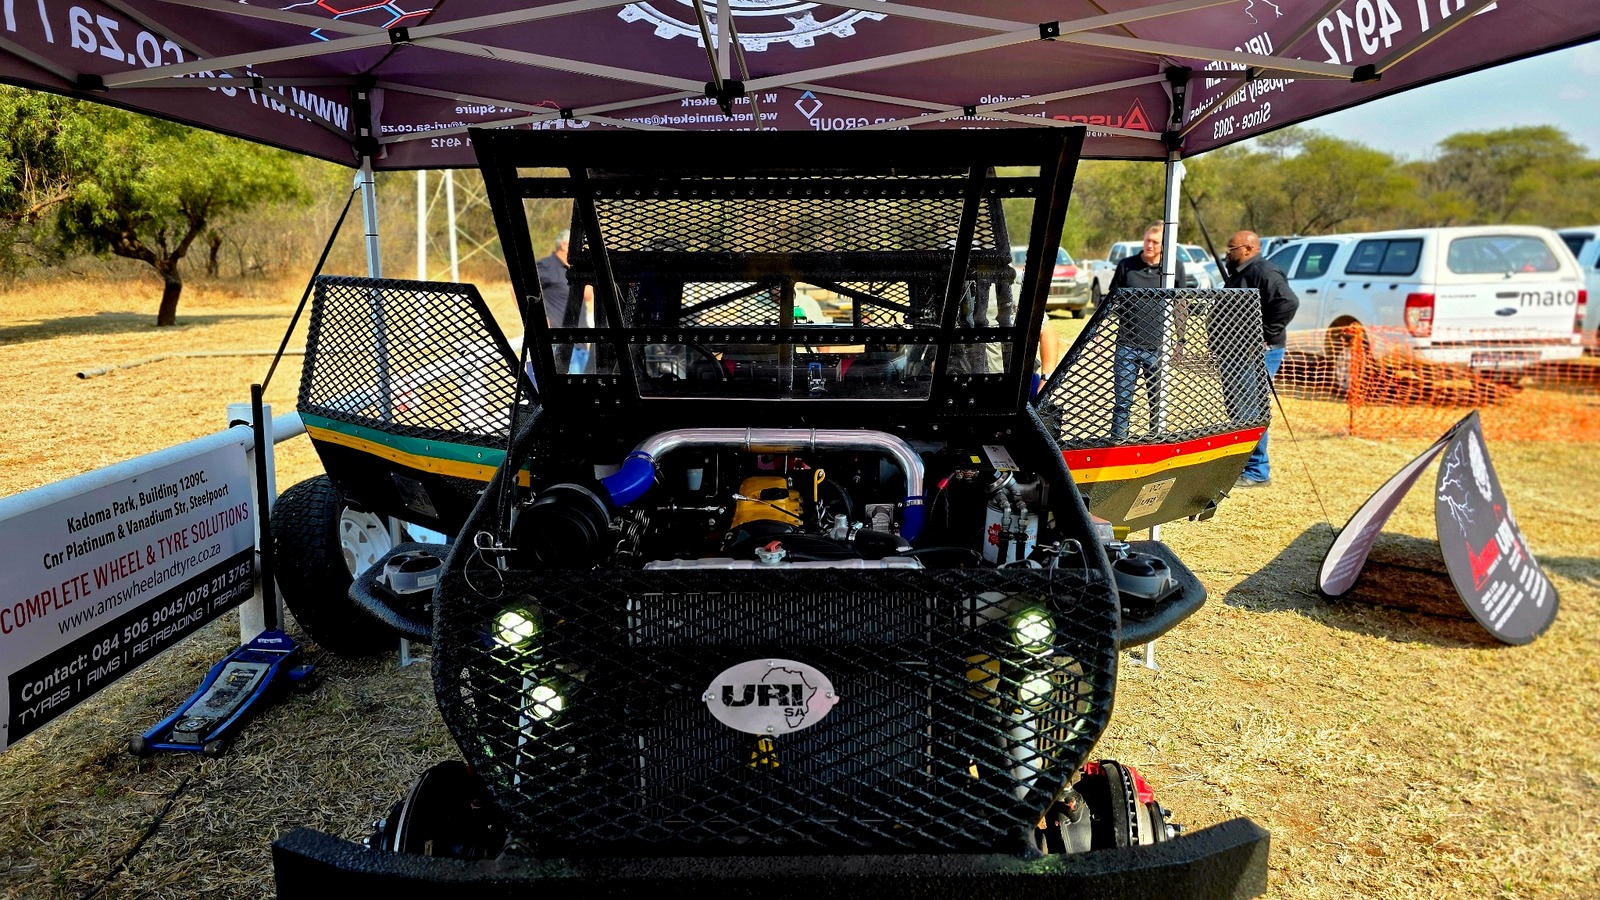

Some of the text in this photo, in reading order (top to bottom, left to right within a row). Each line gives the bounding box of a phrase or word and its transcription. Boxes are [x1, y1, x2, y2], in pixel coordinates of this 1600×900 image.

[43, 483, 229, 570] Cnr Platinum & Vanadium Str, Steelpoort
[66, 470, 208, 534] Kadoma Park, Building 1209C.
[0, 502, 249, 635] COMPLETE WHEEL & TYRE SOLUTIONS
[58, 543, 221, 635] www.amswheelandtyre.co.za
[18, 685, 71, 726] TYRES
[86, 655, 120, 686] RIMS
[132, 607, 203, 658] RETREADING
[213, 578, 251, 610] REPAIRS
[21, 559, 251, 702] Contact: 084 506 9045/078 211 3763
[722, 684, 804, 707] URI
[784, 707, 806, 718] SA
